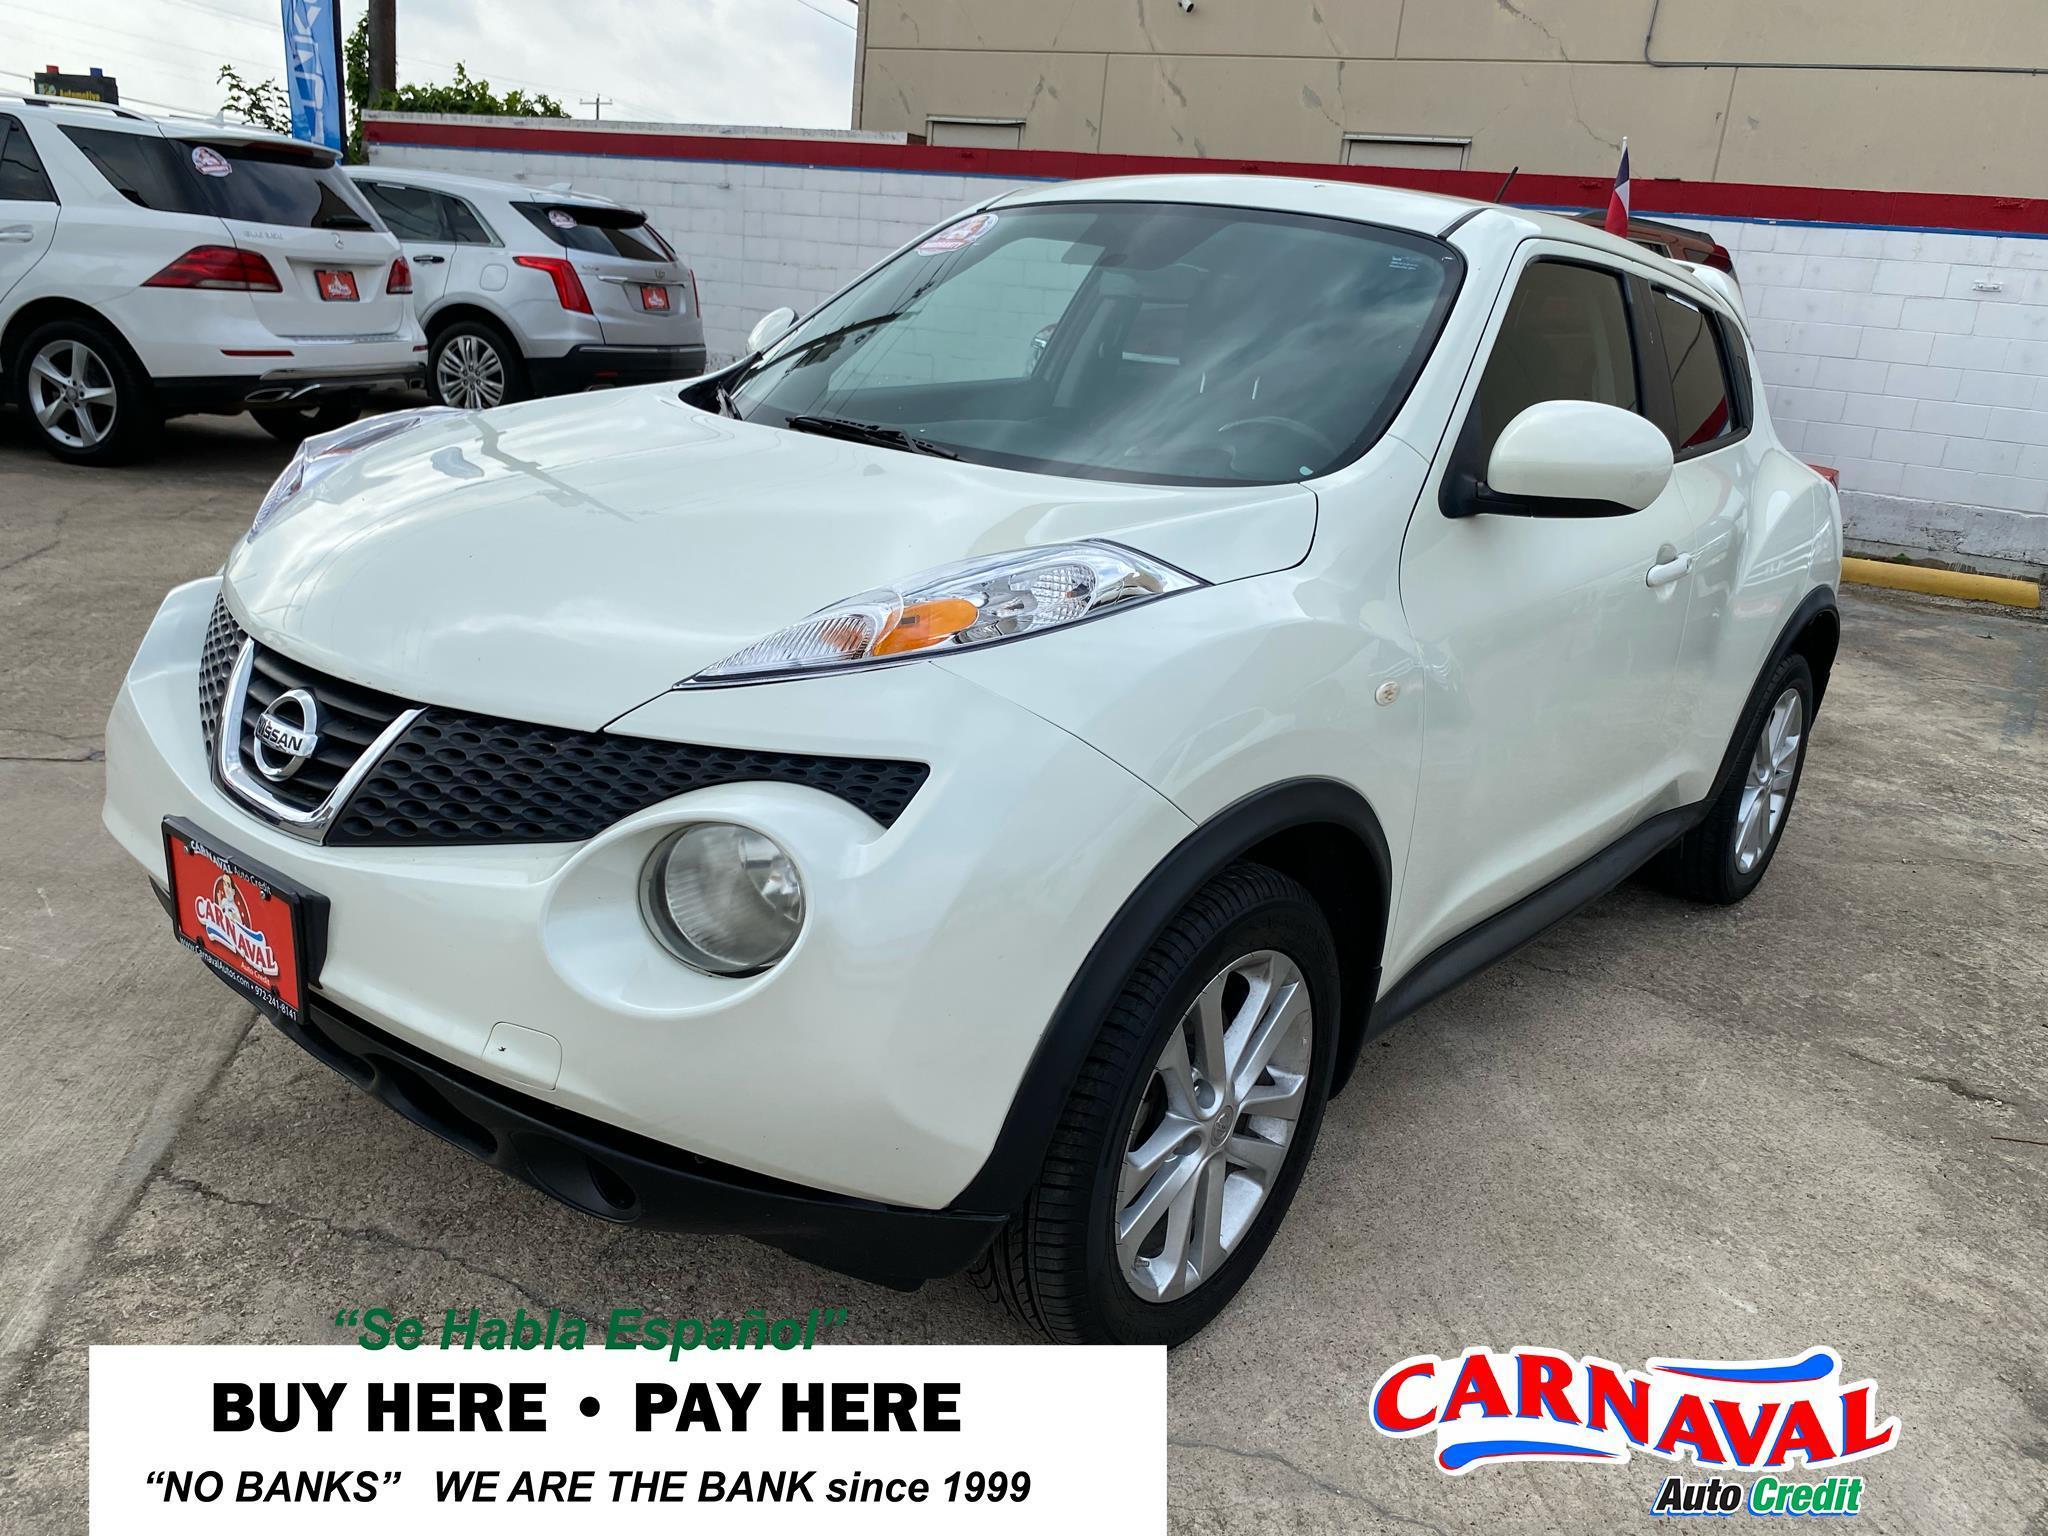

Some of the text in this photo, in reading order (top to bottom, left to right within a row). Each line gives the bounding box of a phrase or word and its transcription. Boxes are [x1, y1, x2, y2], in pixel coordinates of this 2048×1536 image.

[257, 716, 303, 751] NISSAN
[195, 897, 278, 972] CARNAVAL
[253, 969, 270, 987] Credit
